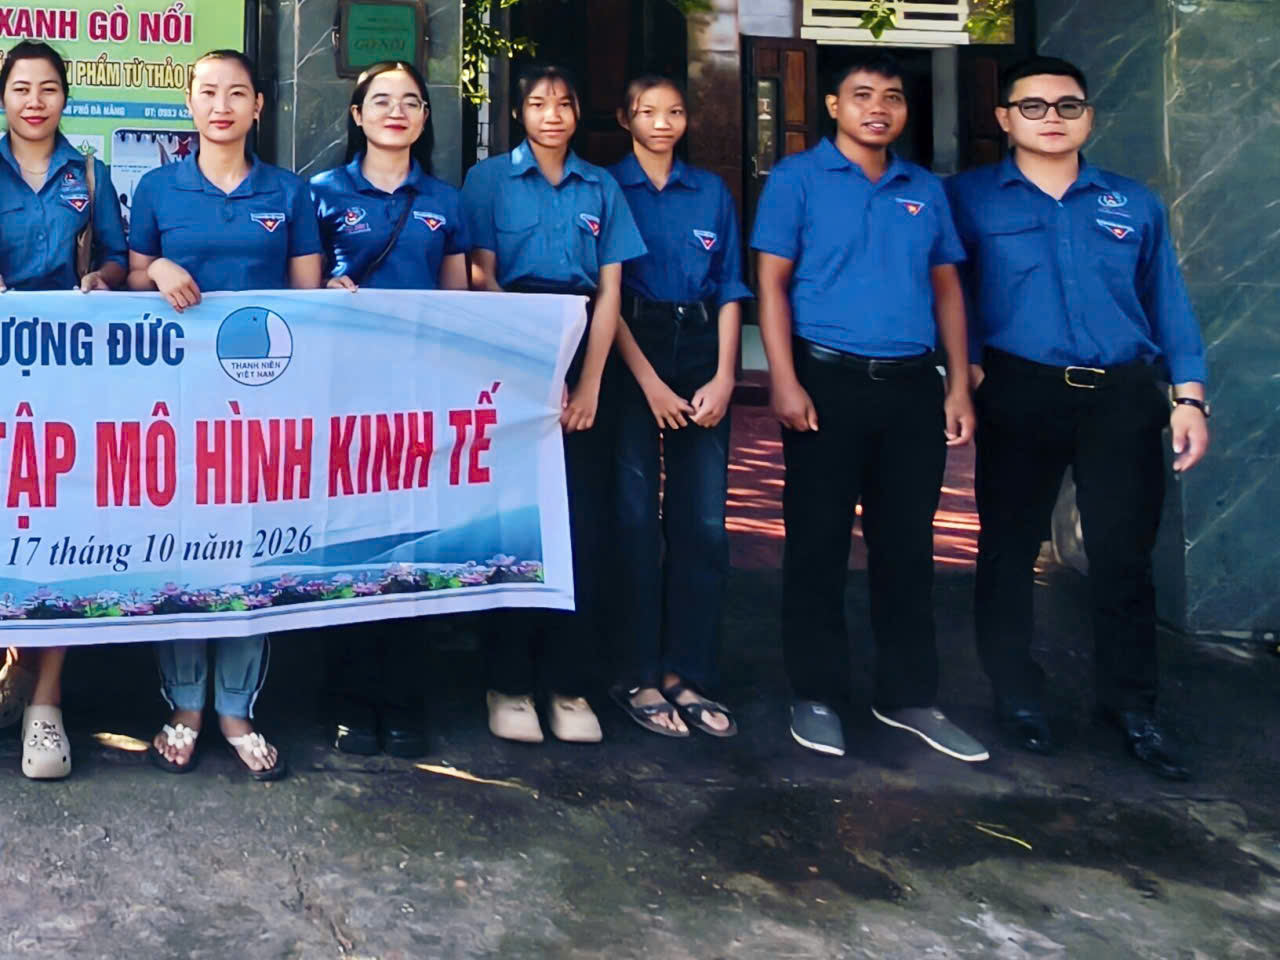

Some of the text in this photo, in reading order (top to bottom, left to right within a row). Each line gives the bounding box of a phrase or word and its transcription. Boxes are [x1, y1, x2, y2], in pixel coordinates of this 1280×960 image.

[89, 4, 129, 42] GÒ
[141, 2, 193, 43] NỔI
[77, 52, 120, 86] PHẨM
[123, 57, 144, 87] TỪ
[145, 56, 185, 89] THẢO
[106, 313, 185, 367] ĐỨC
[261, 360, 281, 369] NIÊN
[96, 401, 177, 507] MÔ
[195, 400, 313, 506] HÌNH
[328, 411, 433, 497] KINH
[449, 382, 502, 485] TẾ
[7, 536, 41, 566] 17
[49, 536, 132, 572] tháng
[143, 533, 174, 563] 10
[183, 535, 243, 561] năm
[252, 525, 313, 559] 2026
